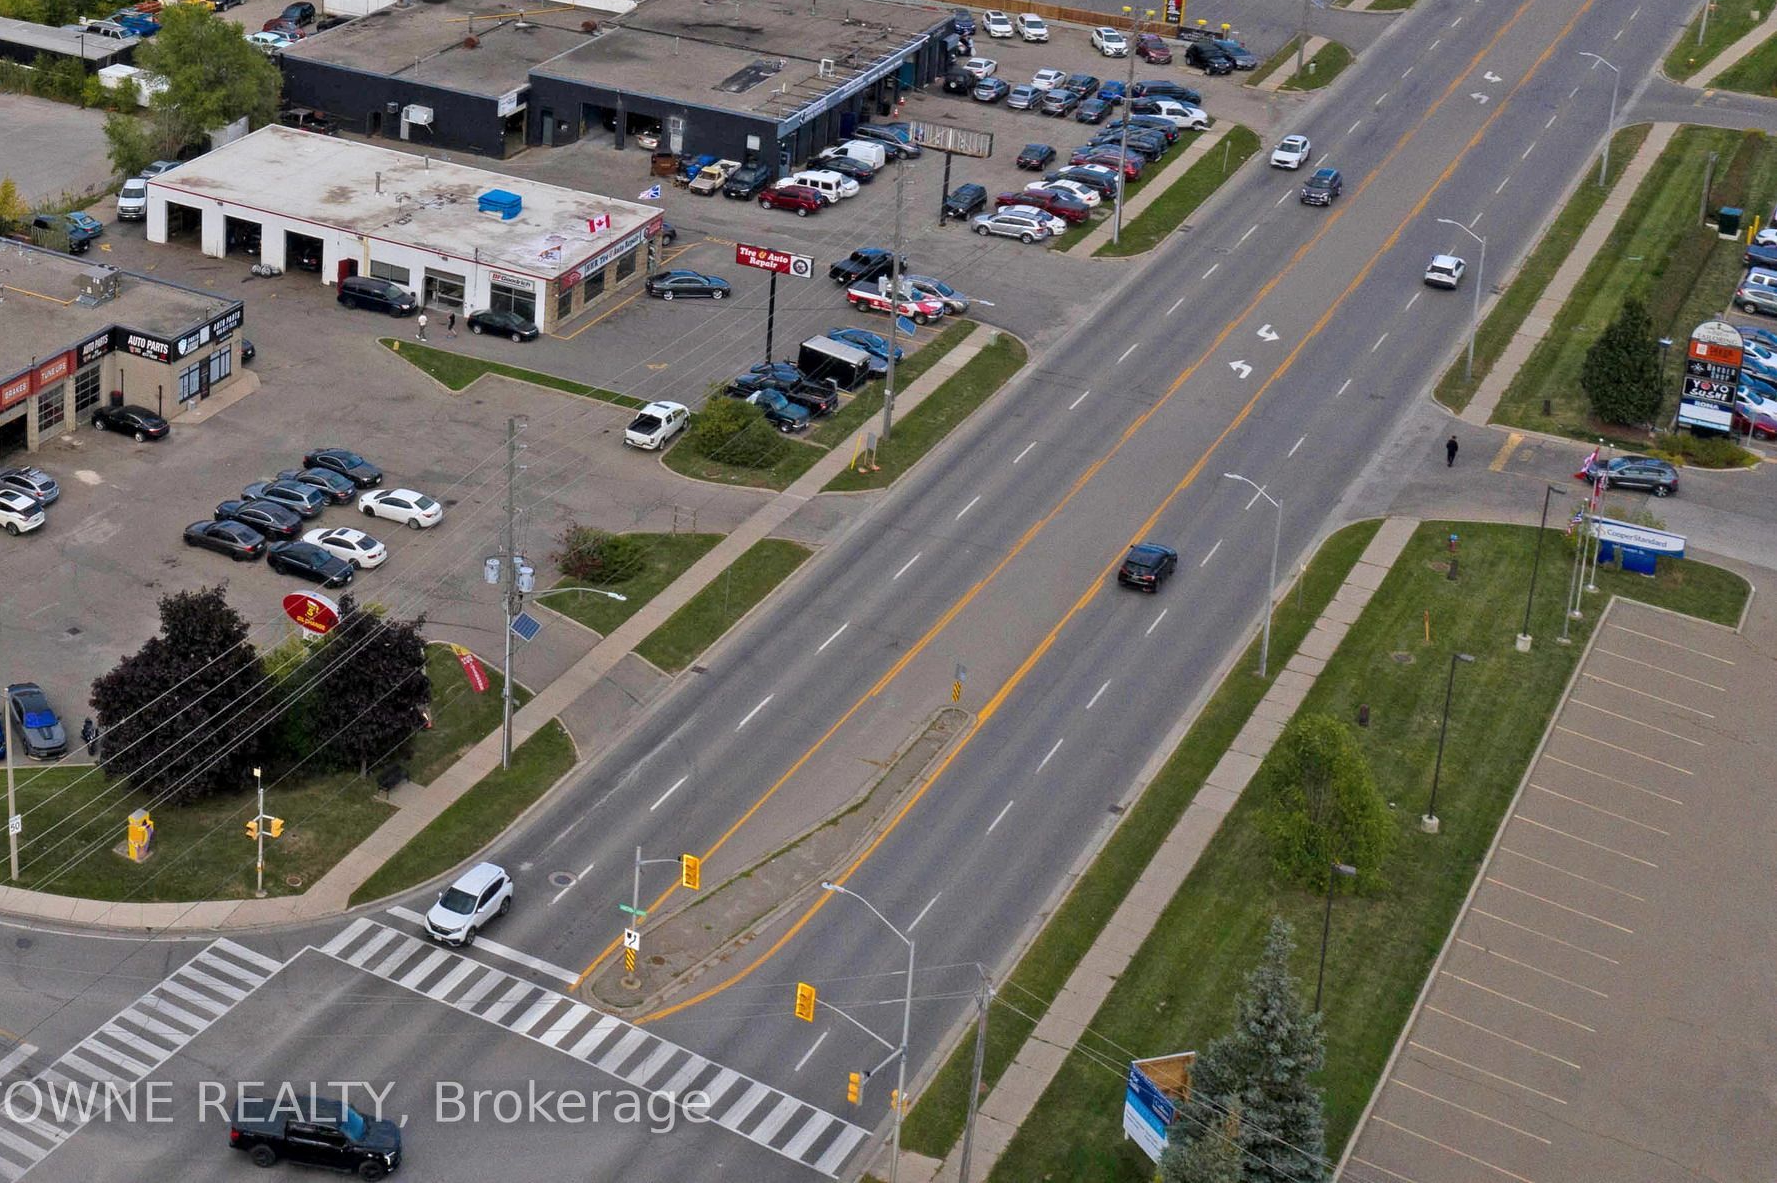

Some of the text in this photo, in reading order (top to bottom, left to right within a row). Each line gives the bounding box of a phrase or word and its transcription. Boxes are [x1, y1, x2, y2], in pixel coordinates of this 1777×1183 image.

[739, 247, 757, 257] Tire
[767, 253, 789, 264] Auto
[749, 257, 778, 269] Repair
[83, 341, 95, 356] AUTO
[94, 334, 109, 349] PARTS
[127, 335, 146, 349] AUTO
[146, 339, 169, 355] PARTS
[41, 362, 67, 379] TUNE UPS
[4, 382, 27, 400] BRAKES
[1693, 379, 1729, 393] YOYO
[1694, 400, 1720, 410] RONA
[10, 821, 21, 833] 50
